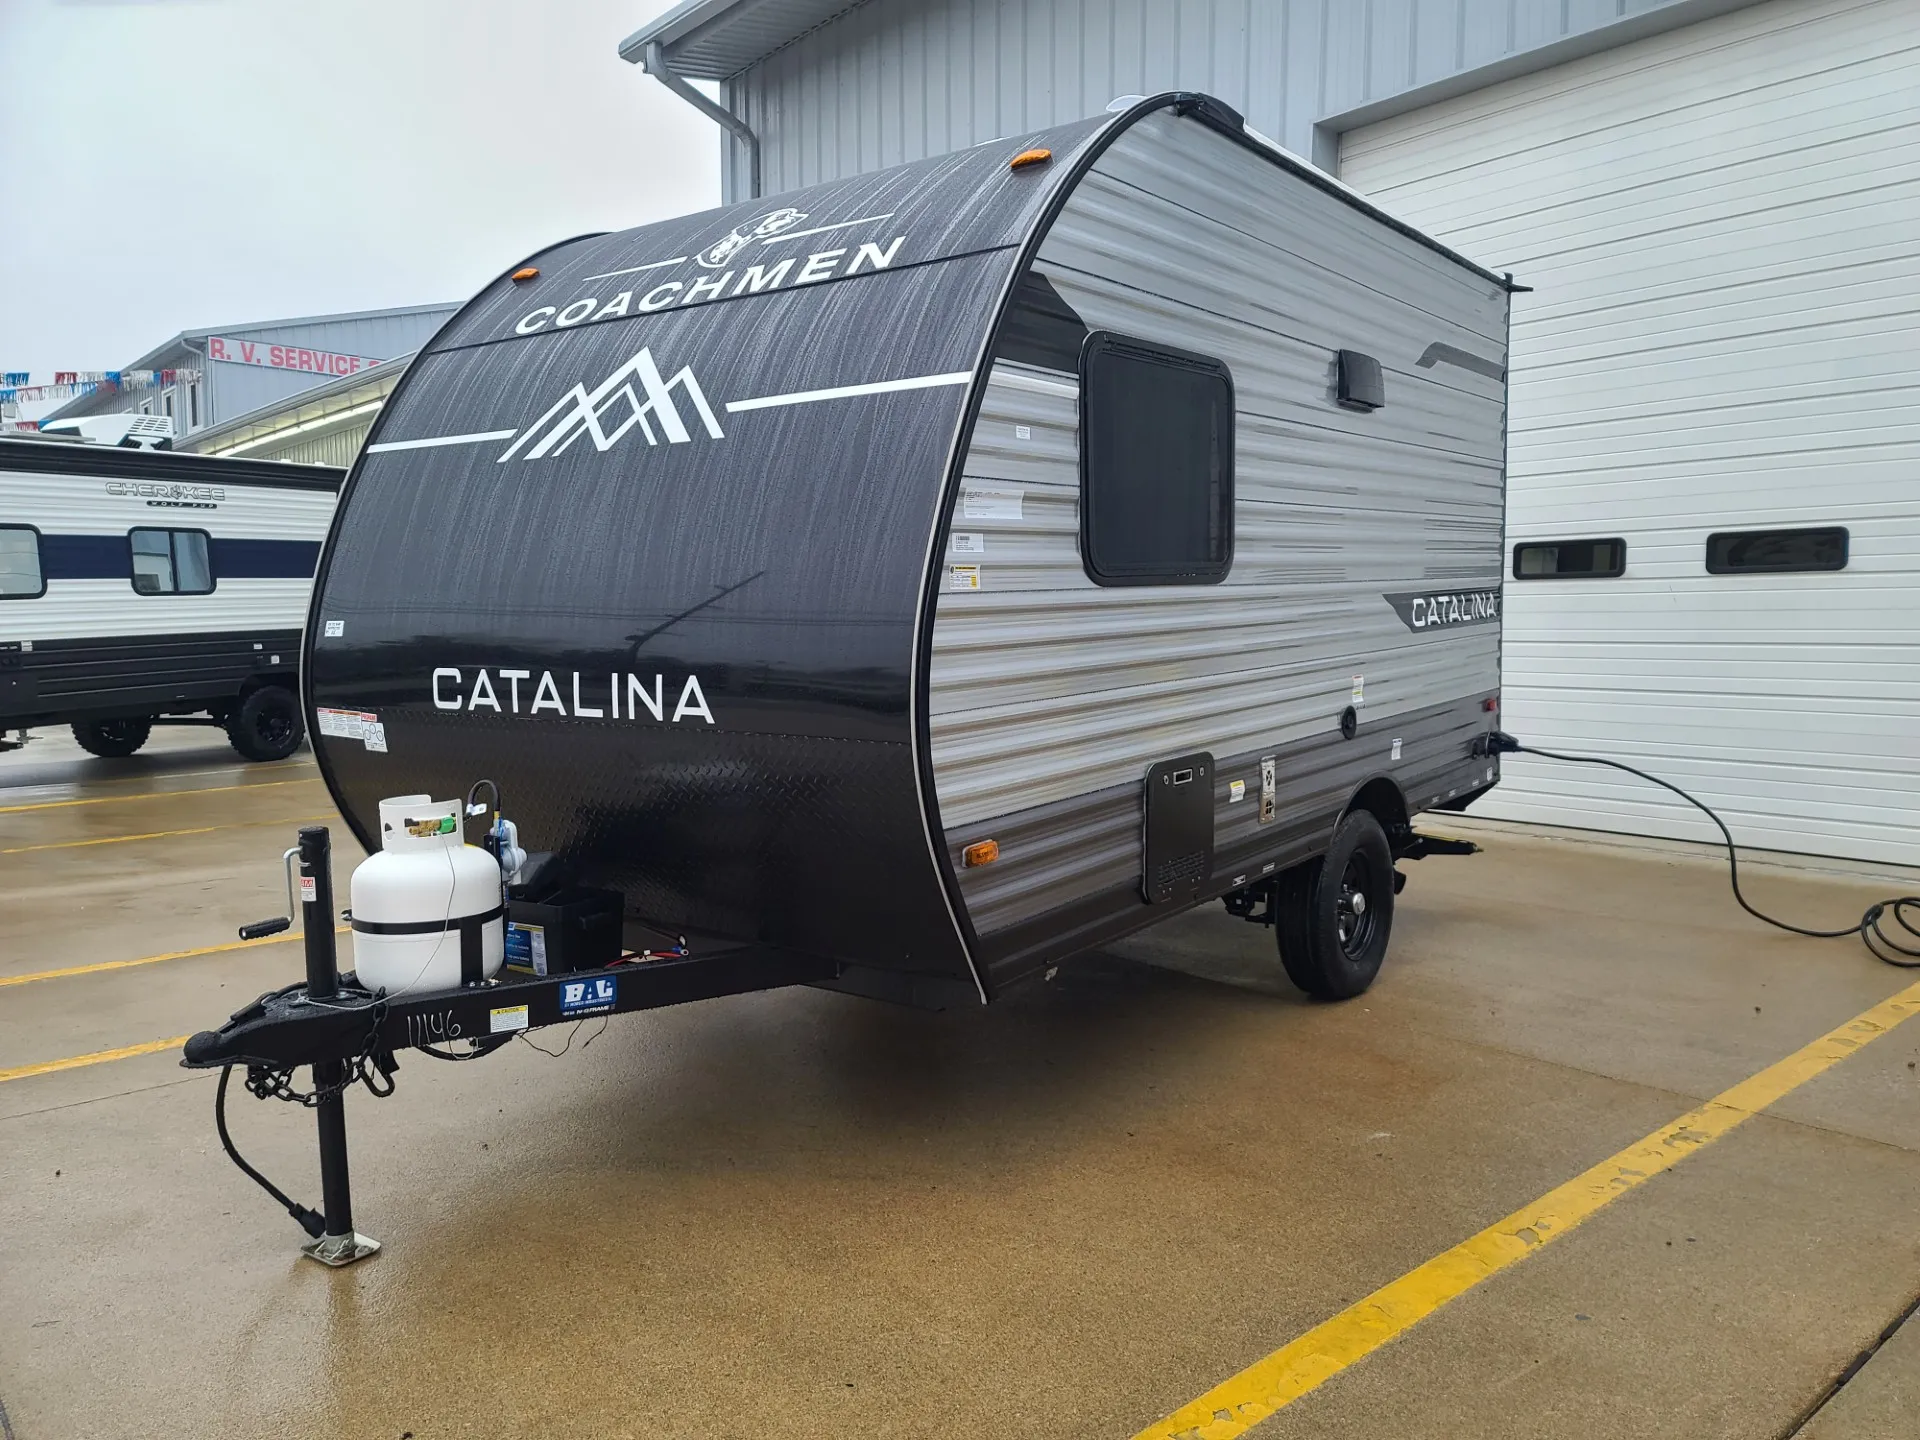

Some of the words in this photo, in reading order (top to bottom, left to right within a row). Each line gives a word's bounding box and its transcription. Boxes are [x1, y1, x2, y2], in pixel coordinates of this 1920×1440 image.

[515, 236, 906, 334] COACHMEN
[210, 338, 232, 360] R.
[240, 341, 262, 364] V.
[269, 346, 361, 375] SERVICE
[1412, 591, 1497, 627] CATALINA
[432, 667, 716, 724] CATALINA
[564, 980, 613, 1003] BAL
